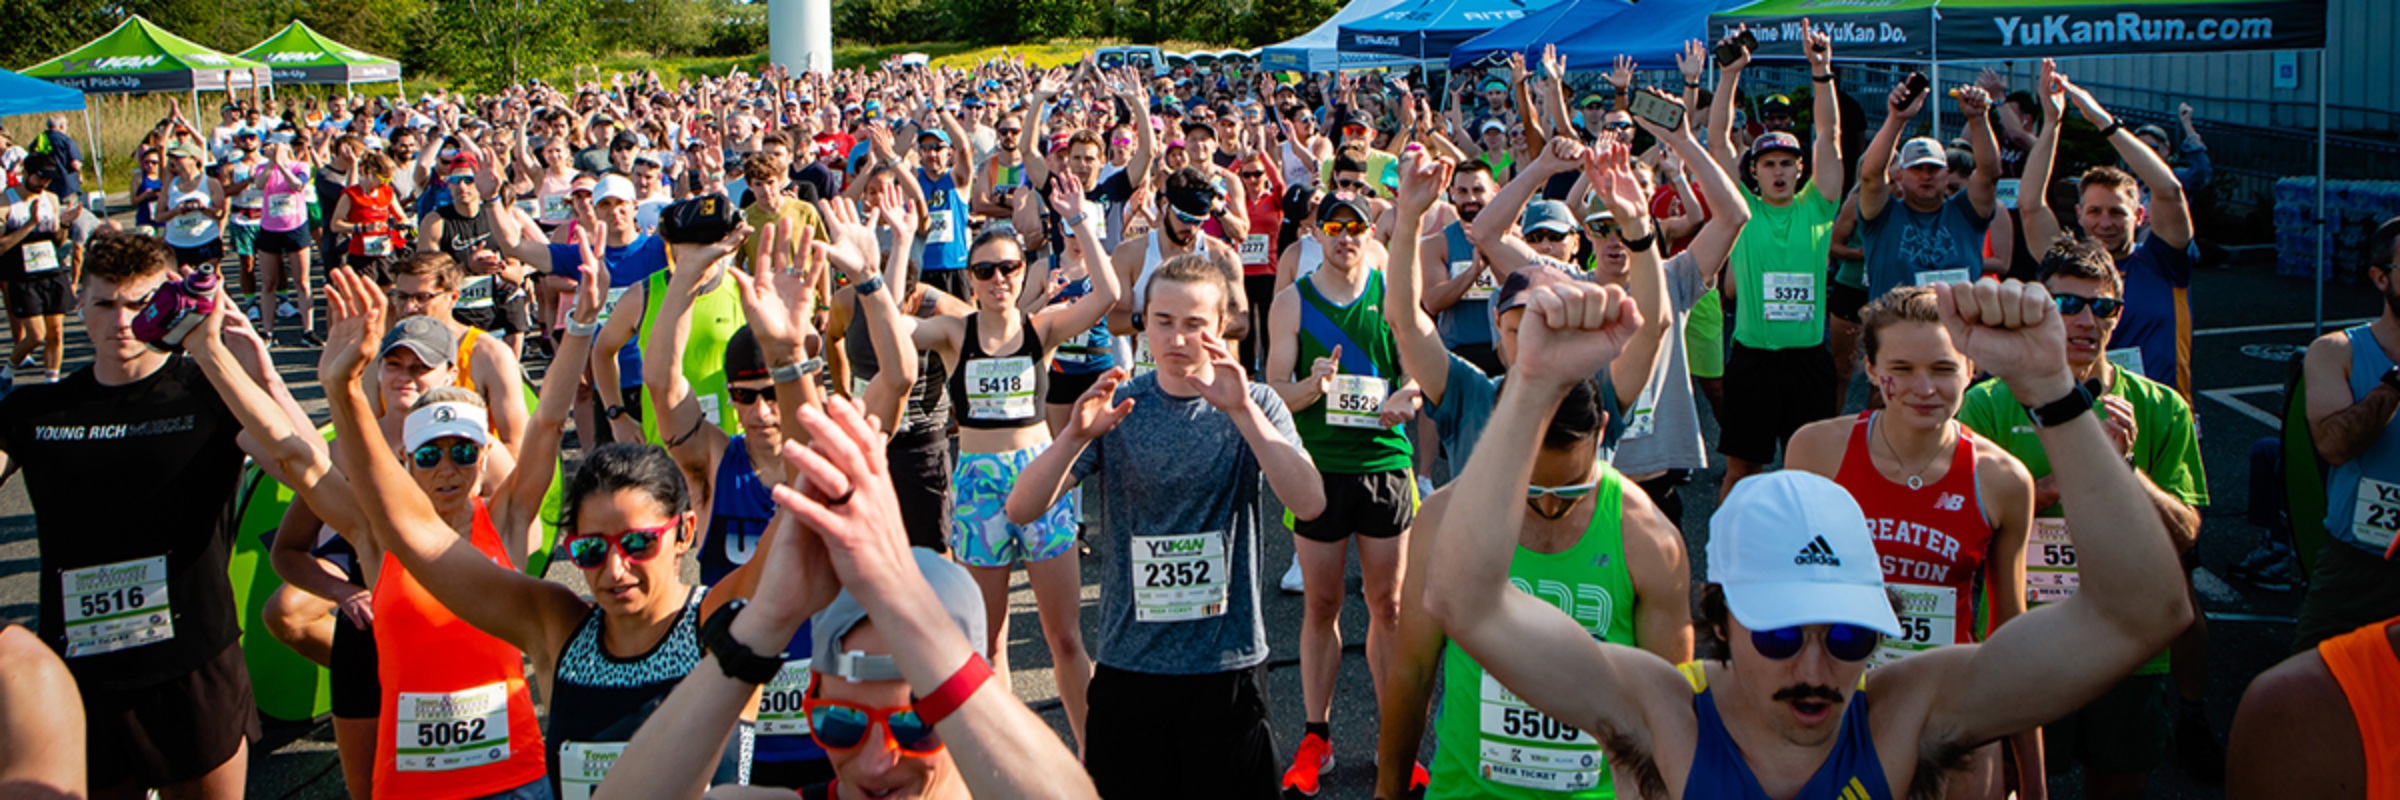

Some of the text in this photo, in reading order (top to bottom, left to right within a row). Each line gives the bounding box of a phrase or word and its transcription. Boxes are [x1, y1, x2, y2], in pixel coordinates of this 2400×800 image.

[1781, 22, 1819, 42] Wht
[1824, 22, 1876, 42] YuKan
[1879, 22, 1907, 43] Do.
[1994, 12, 2273, 47] YuKanRun.com
[90, 76, 141, 88] Pick-Up
[272, 69, 307, 80] ick-Up
[1774, 286, 1809, 301] 5373
[979, 375, 1022, 393] 5418
[35, 425, 86, 441] YOUNG
[88, 423, 128, 440] RICH
[2365, 504, 2400, 531] 23
[1146, 537, 1206, 558] YUKAN
[1866, 517, 1961, 563] REATER
[1794, 554, 1841, 567] adidas
[2044, 544, 2077, 566] 55
[1144, 560, 1211, 588] 2352
[1882, 554, 1951, 583] STON
[80, 586, 145, 617] 5516
[1884, 616, 1932, 643] 55
[759, 689, 807, 713] 500
[417, 717, 487, 747] 5062
